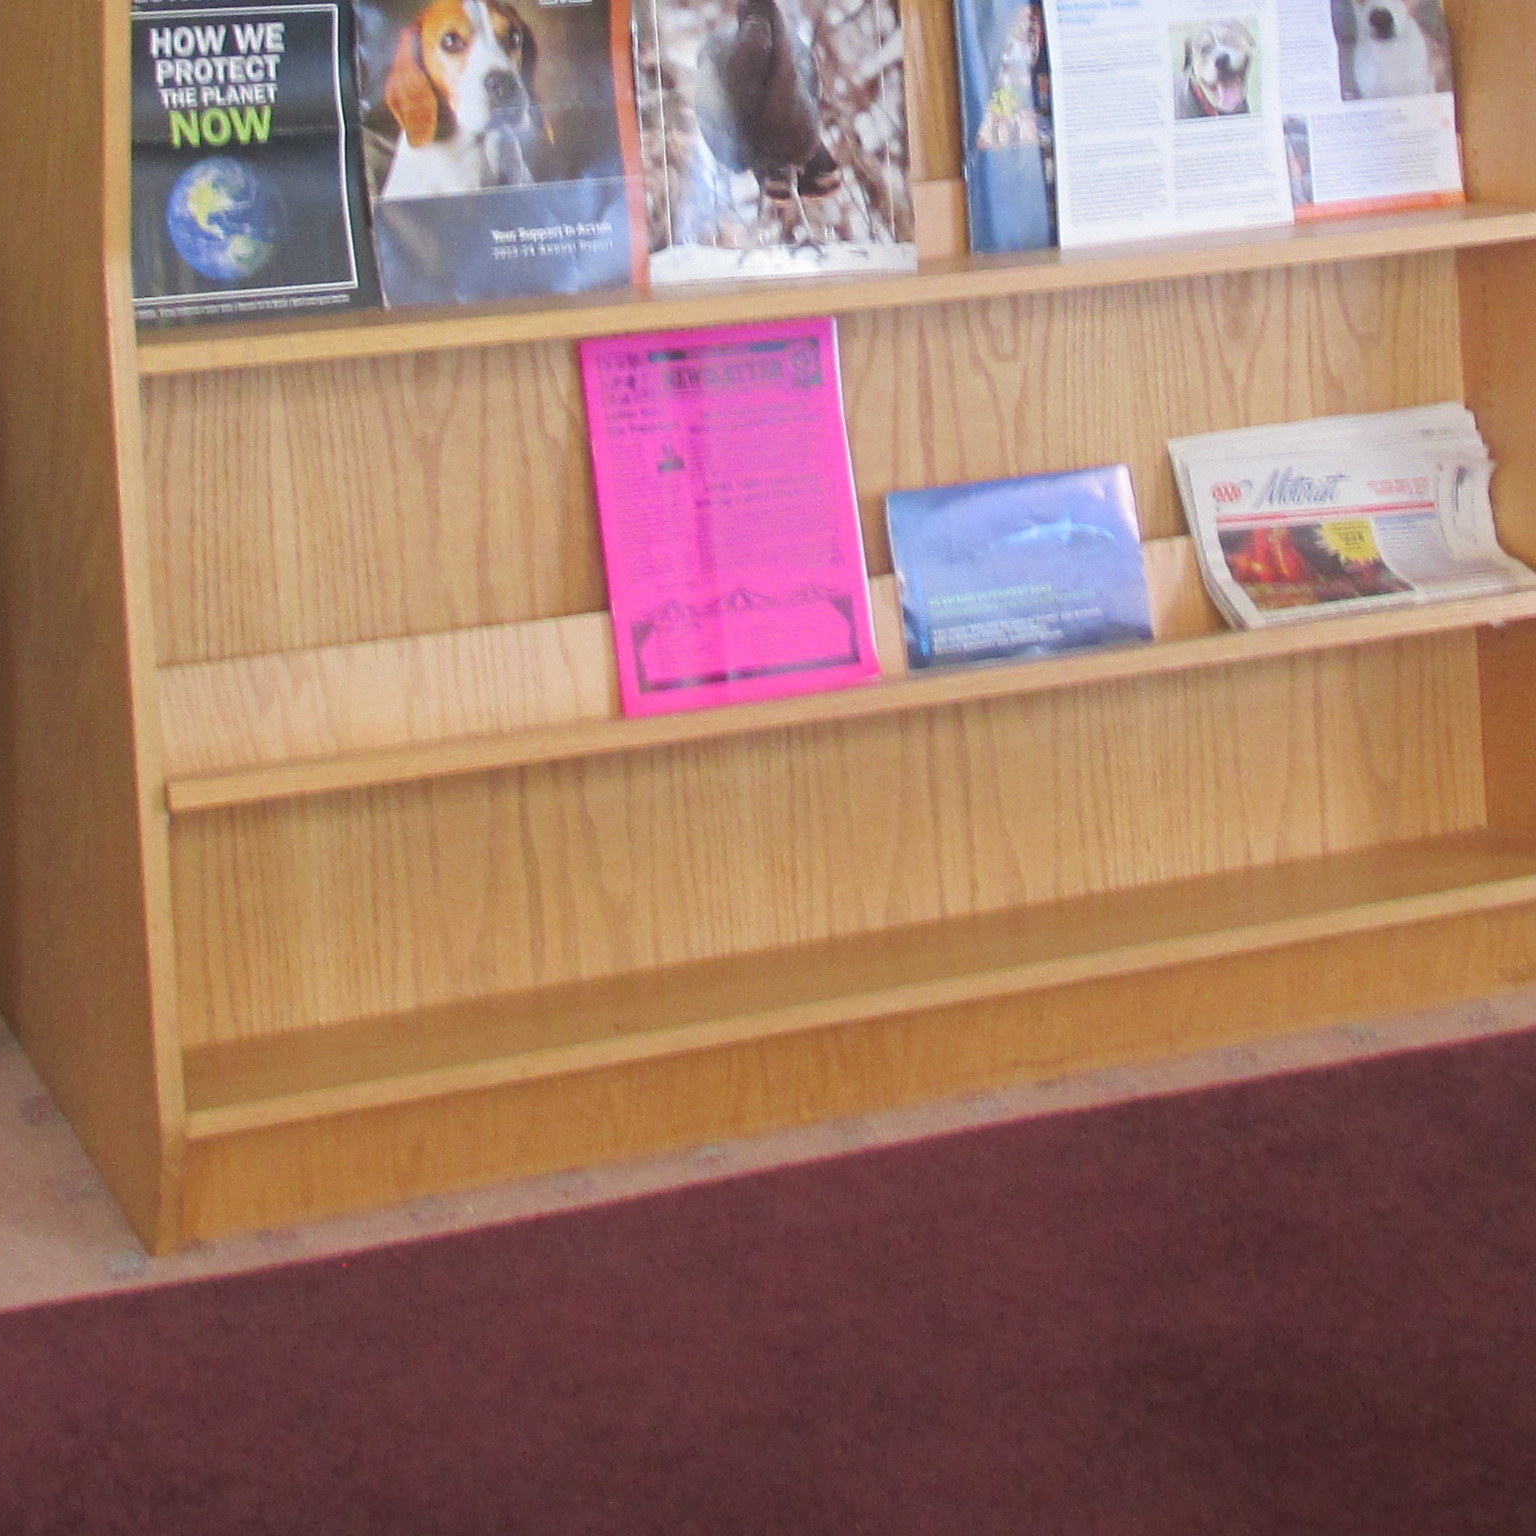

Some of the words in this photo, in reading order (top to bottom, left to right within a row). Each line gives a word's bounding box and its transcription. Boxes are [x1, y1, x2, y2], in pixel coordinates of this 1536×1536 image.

[148, 25, 226, 60] HOW
[232, 21, 286, 55] WE
[153, 52, 281, 87] PROTECT
[159, 84, 197, 109] THE
[200, 81, 278, 107] PLANET
[168, 104, 273, 150] NOW
[490, 228, 517, 244] Your
[517, 225, 563, 243] Support
